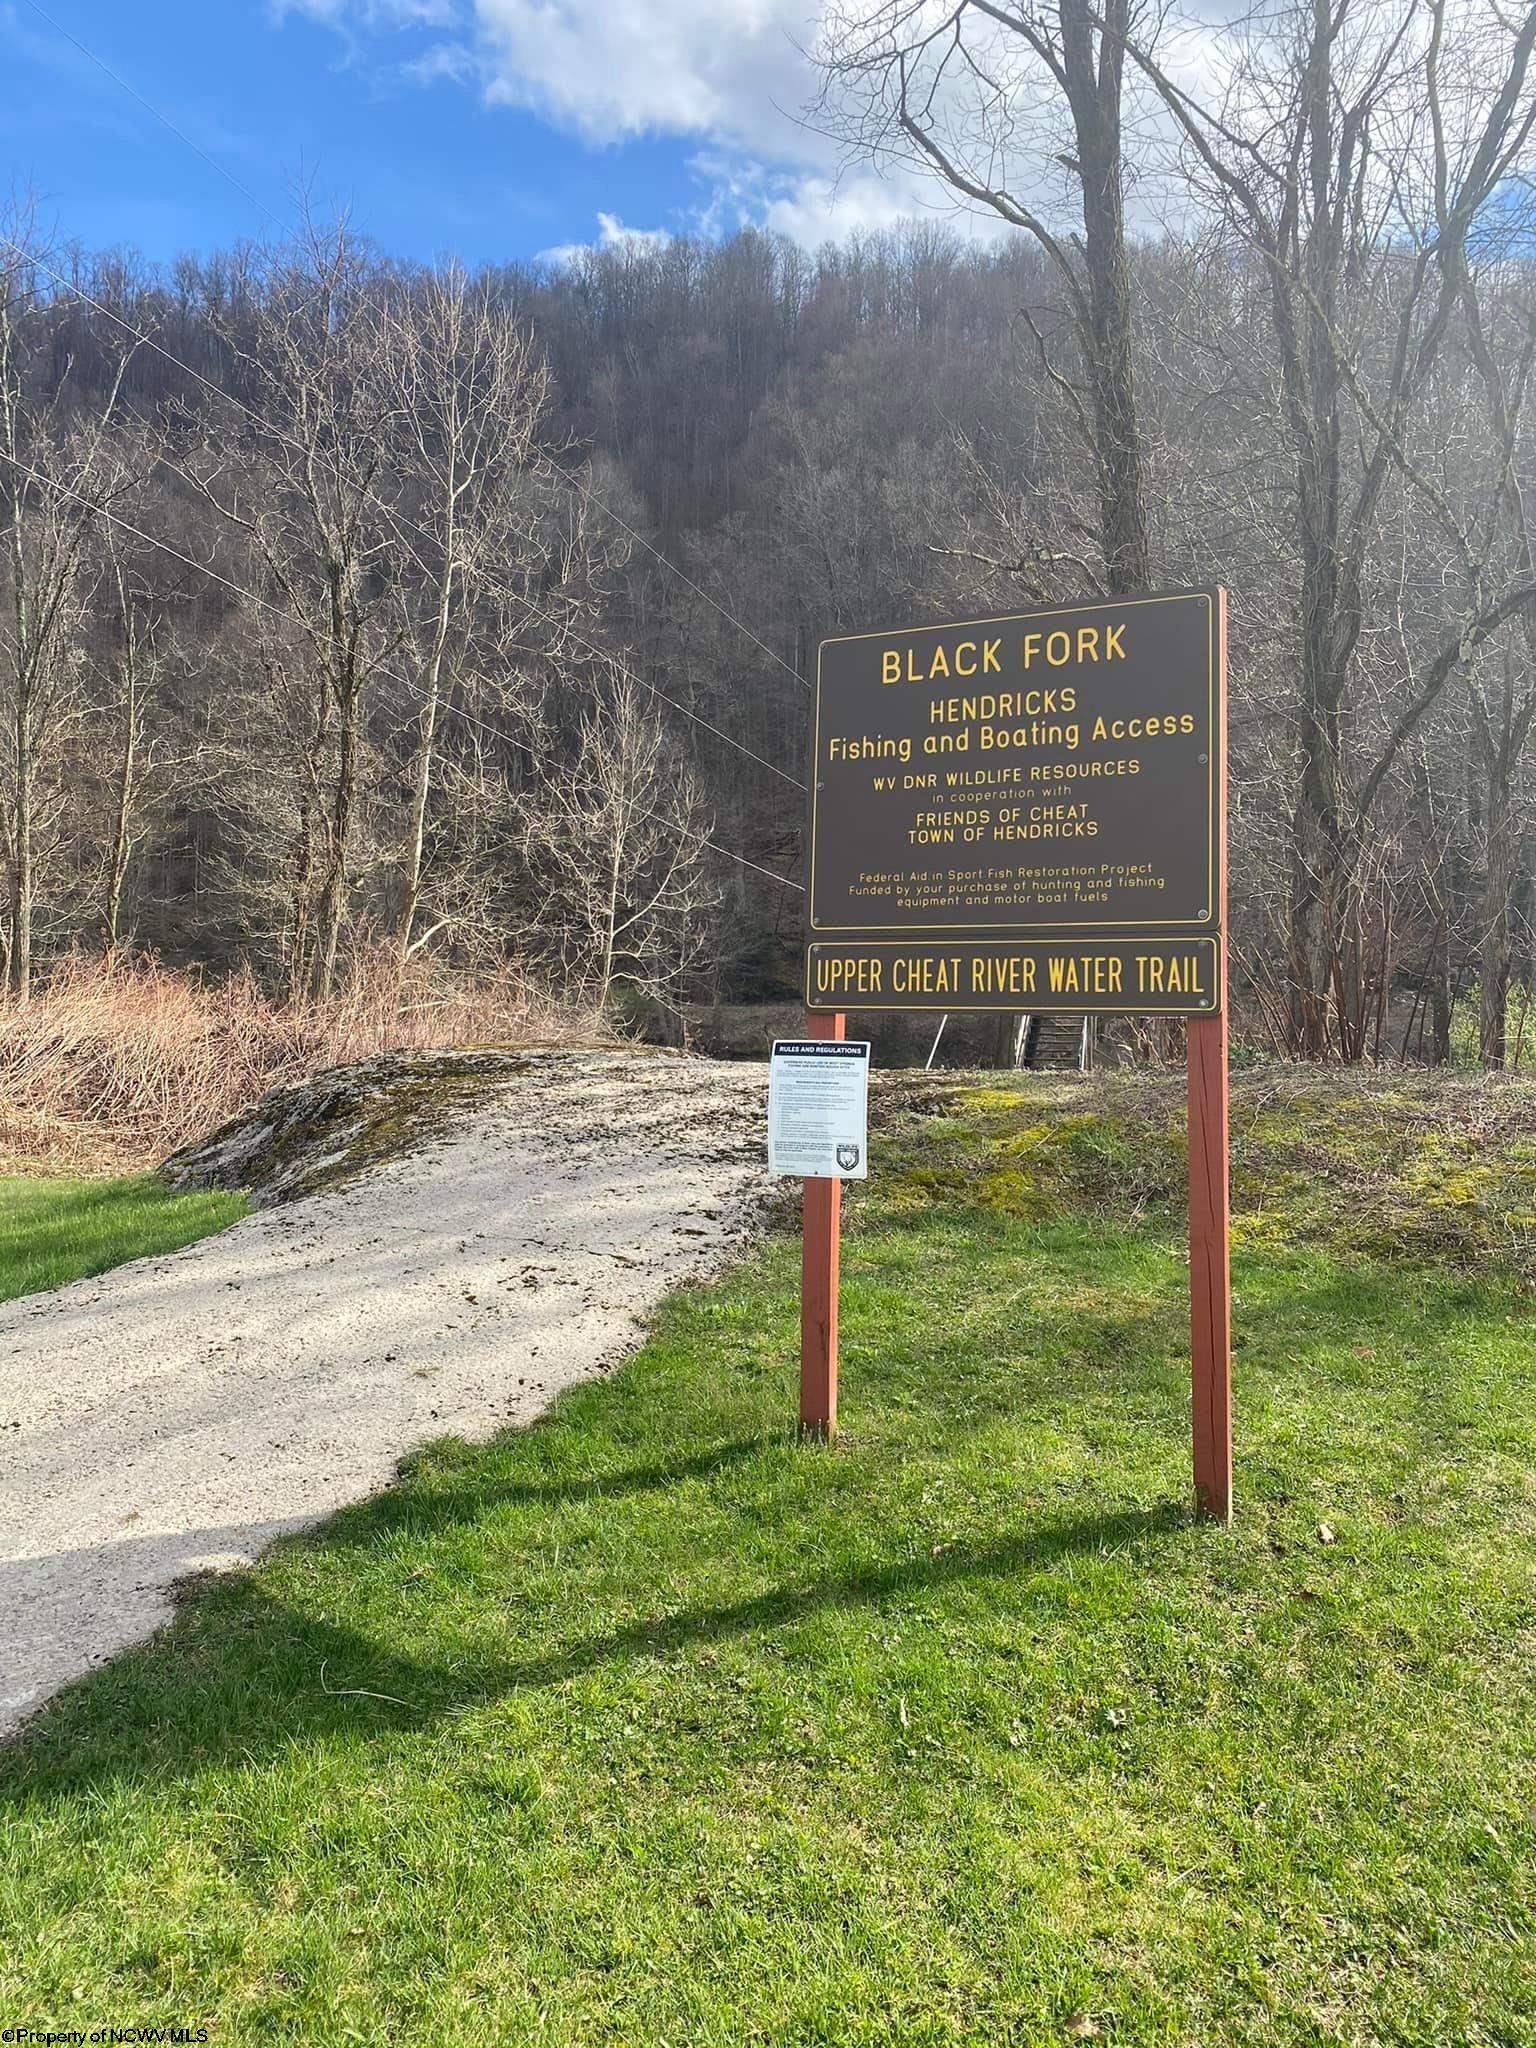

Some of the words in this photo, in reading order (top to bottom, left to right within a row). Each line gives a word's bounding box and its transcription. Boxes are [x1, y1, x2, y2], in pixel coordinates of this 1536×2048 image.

[881, 638, 1002, 685] BLACK
[1024, 624, 1127, 669] FORK
[930, 687, 1076, 724] HENDRICKS
[829, 736, 911, 763] Fishing
[924, 729, 969, 754] and
[981, 722, 1080, 751] Boating
[1092, 714, 1195, 741] Access
[873, 777, 897, 792] WV
[903, 774, 938, 789] DNR
[946, 768, 1022, 787] WILDLIFE
[1030, 760, 1141, 781] RESOURCES
[932, 793, 944, 803] in
[950, 787, 1035, 805] cooperation
[1042, 785, 1072, 798] with
[916, 810, 990, 827] FRIENDS
[999, 807, 1021, 823] OF
[1030, 804, 1090, 821] CHEAT
[908, 829, 955, 844] TOWN
[963, 827, 985, 841] OF
[993, 822, 1099, 840] HENDRICKS
[859, 872, 904, 883] Federal
[910, 871, 929, 881] Aid
[932, 871, 943, 881] in
[948, 869, 983, 881] Sport
[987, 868, 1013, 879] Fish
[1018, 865, 1096, 877] Restoration
[1100, 863, 1152, 876] Project
[849, 885, 892, 896] Funded
[896, 884, 911, 896] by
[915, 884, 943, 895] your
[948, 881, 1007, 893] purchase
[1013, 880, 1026, 890] of
[1032, 879, 1081, 891] hunting
[1087, 878, 1112, 888] and
[1118, 875, 1165, 888] fishing
[897, 895, 960, 908] equipment
[965, 894, 989, 905] and
[994, 894, 1031, 904] motor
[1037, 893, 1068, 903] boat
[1074, 891, 1108, 902] fuels
[816, 958, 882, 993] UPPER
[892, 958, 963, 993] CHEAT
[972, 958, 1037, 993] RIVER
[1048, 957, 1123, 993] WATER
[1136, 957, 1204, 993] TRAIL
